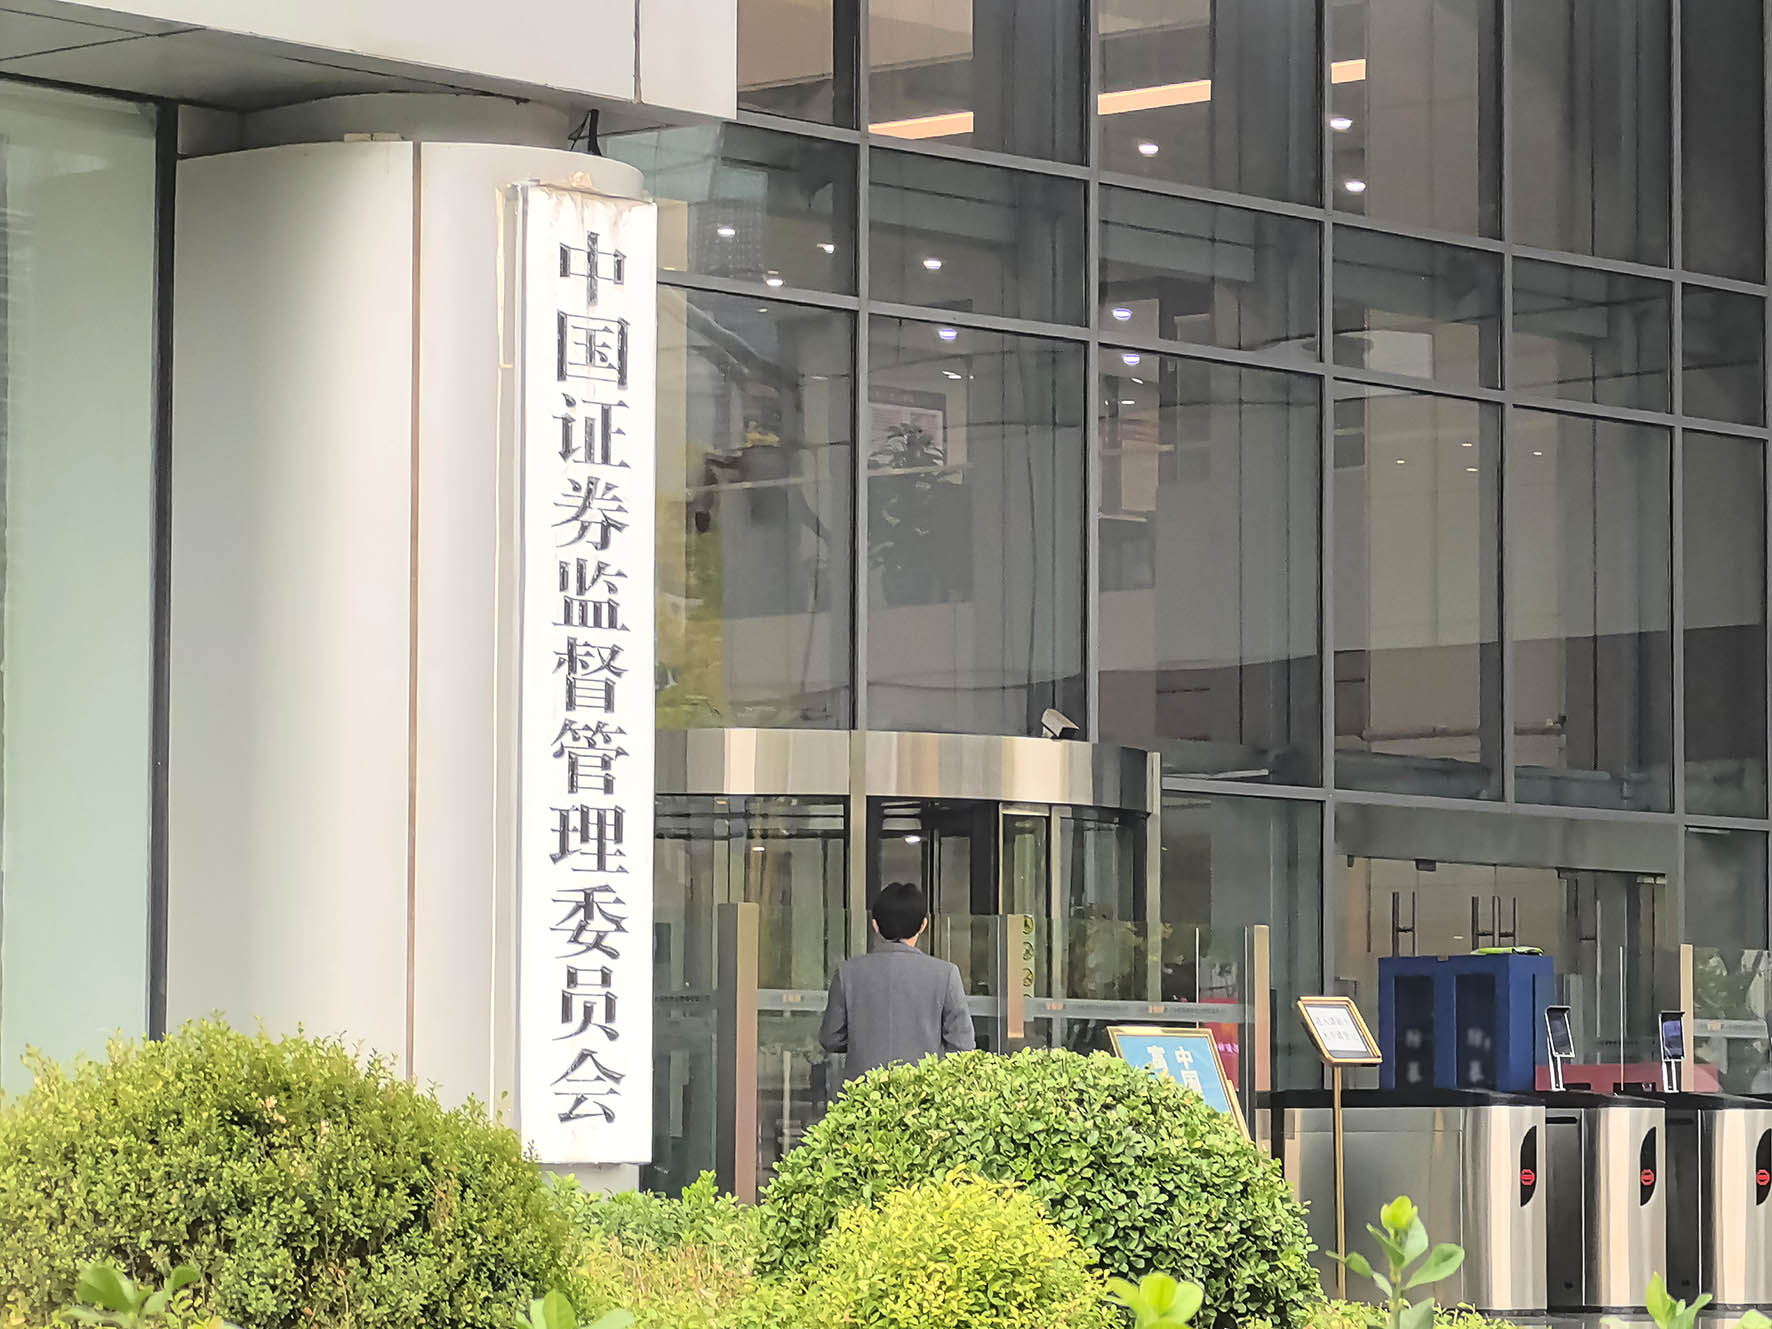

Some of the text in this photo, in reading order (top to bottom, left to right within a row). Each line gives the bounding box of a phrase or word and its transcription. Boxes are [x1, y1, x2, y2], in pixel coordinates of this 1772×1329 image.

[550, 230, 631, 1123] 中国证券监督管理委员会
